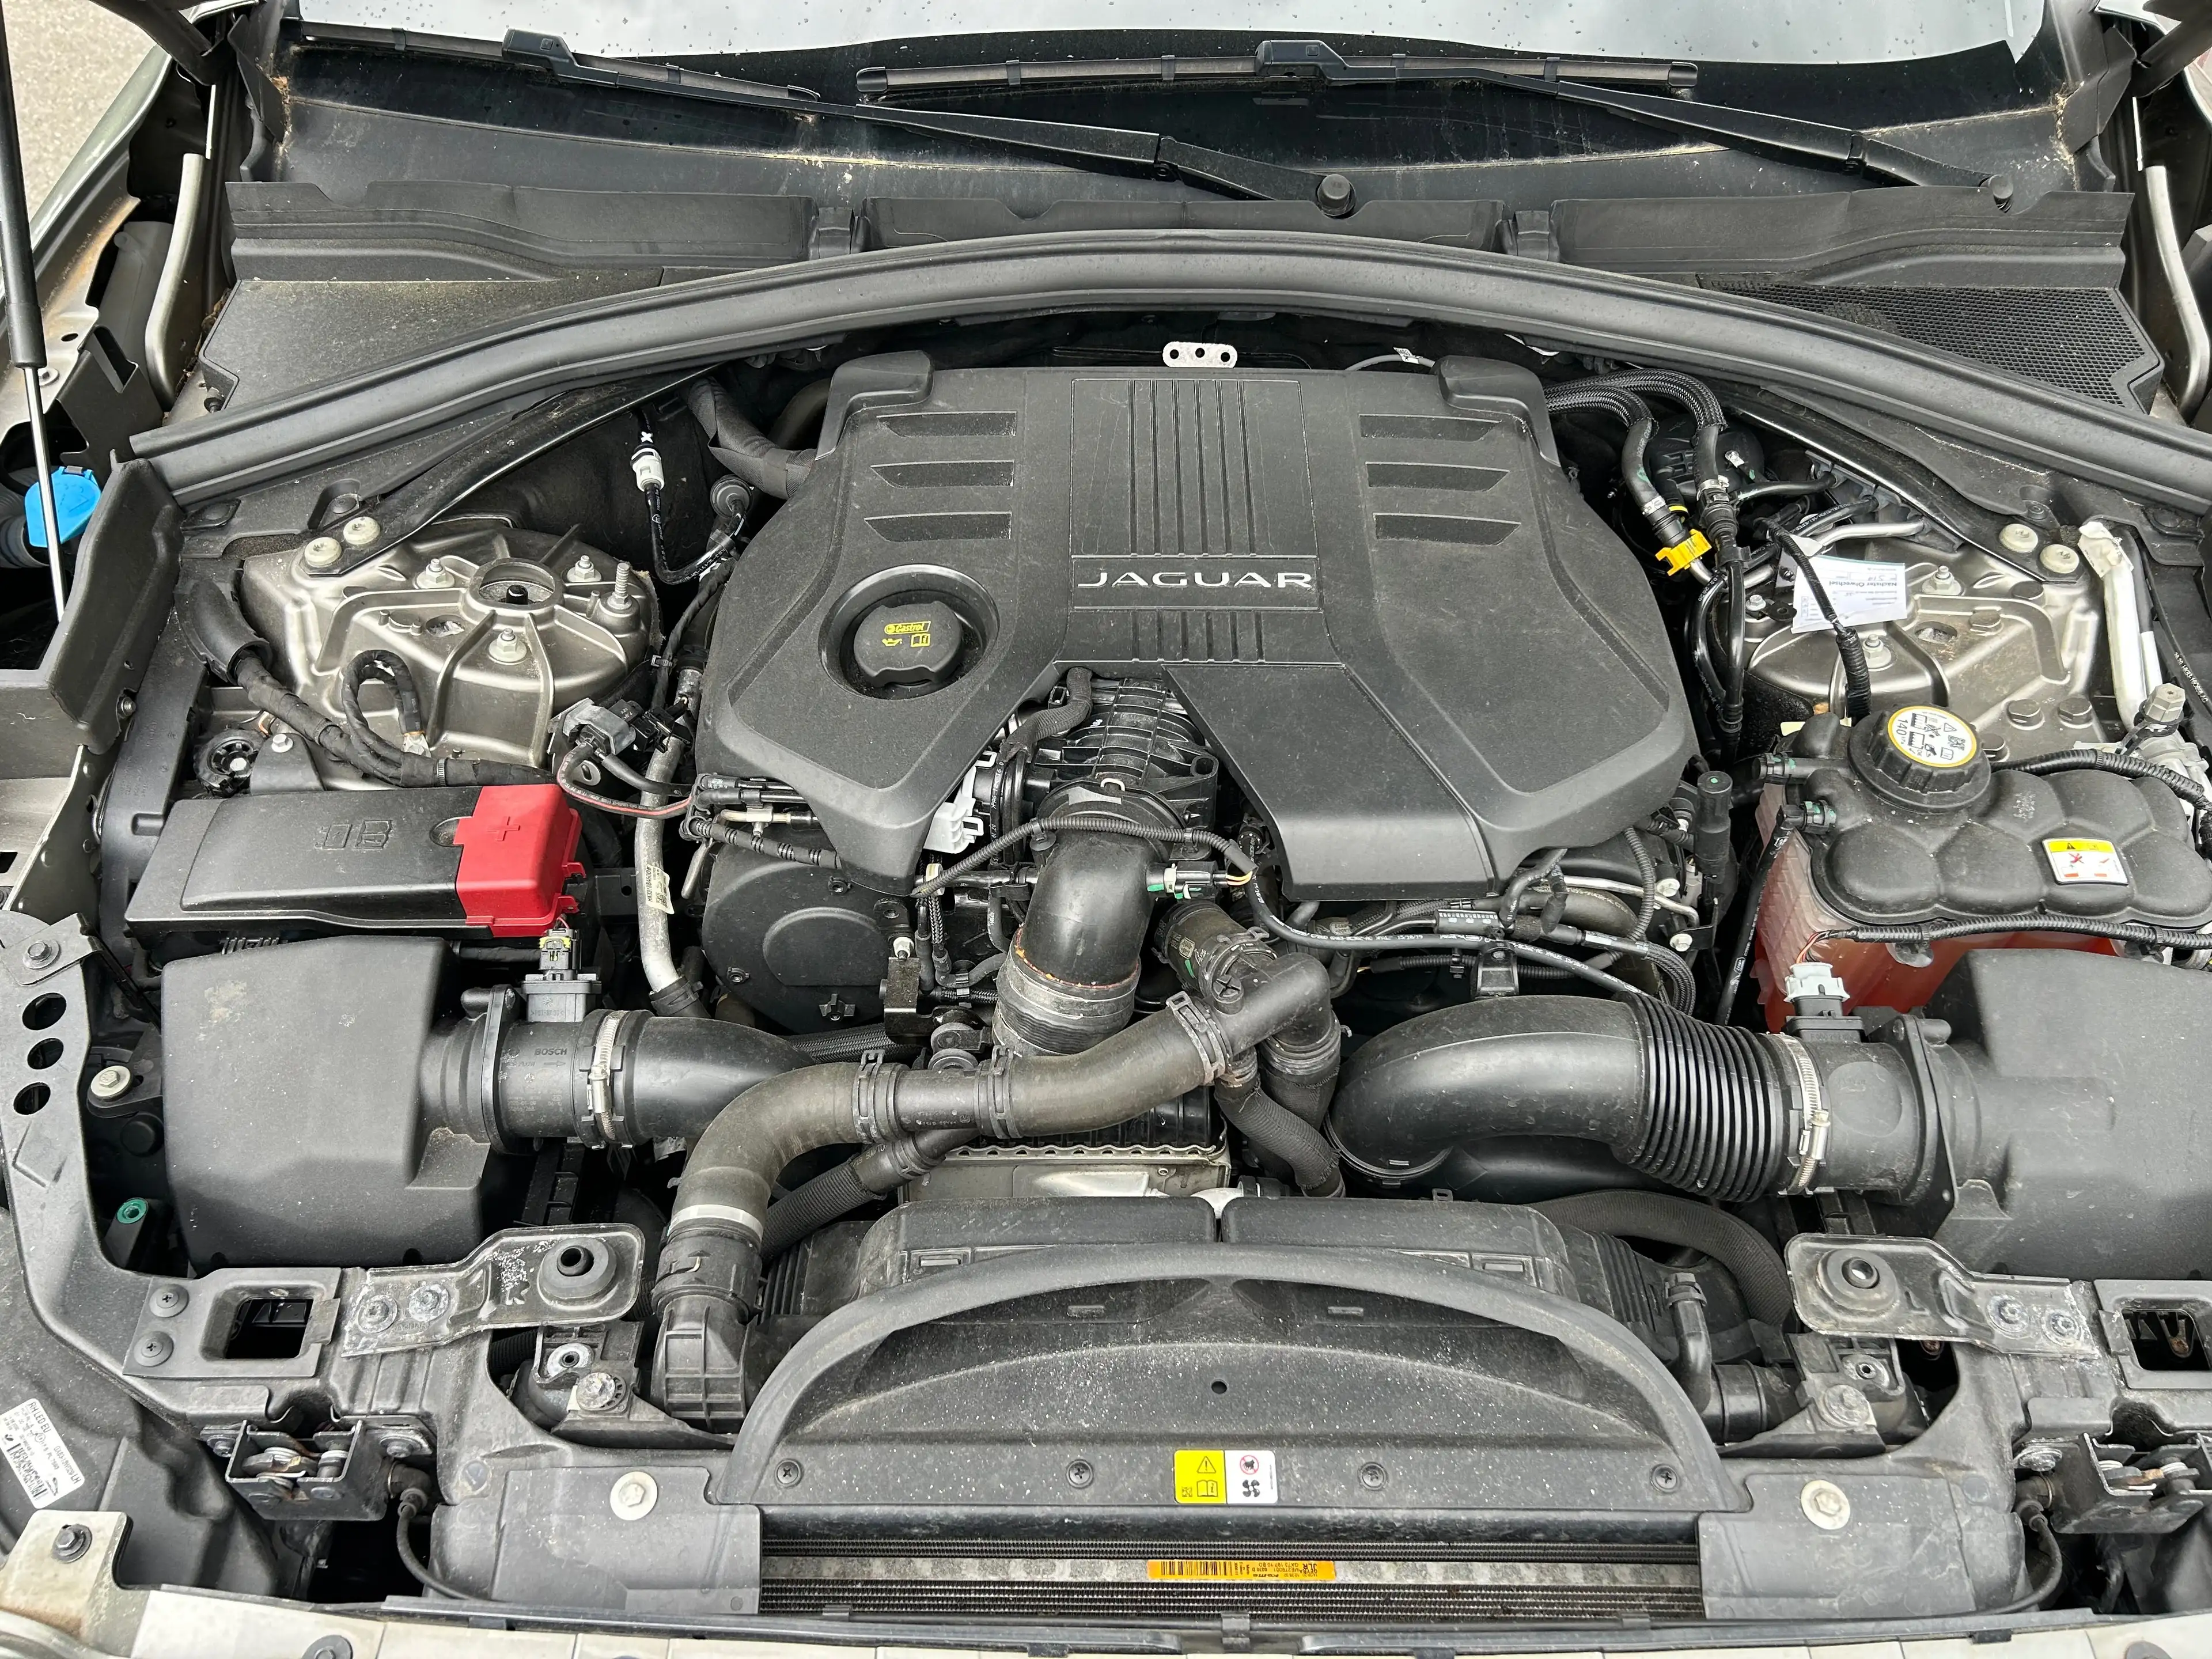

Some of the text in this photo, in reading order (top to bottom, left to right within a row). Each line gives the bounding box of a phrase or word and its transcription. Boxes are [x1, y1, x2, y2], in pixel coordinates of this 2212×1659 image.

[1077, 572, 1313, 588] JAGUAR
[895, 623, 925, 633] Castrol
[1896, 719, 1908, 736] 140
[534, 1048, 568, 1056] BOSCH
[29, 1402, 39, 1412] RH
[33, 1410, 46, 1424] LED
[40, 1423, 51, 1433] EU
